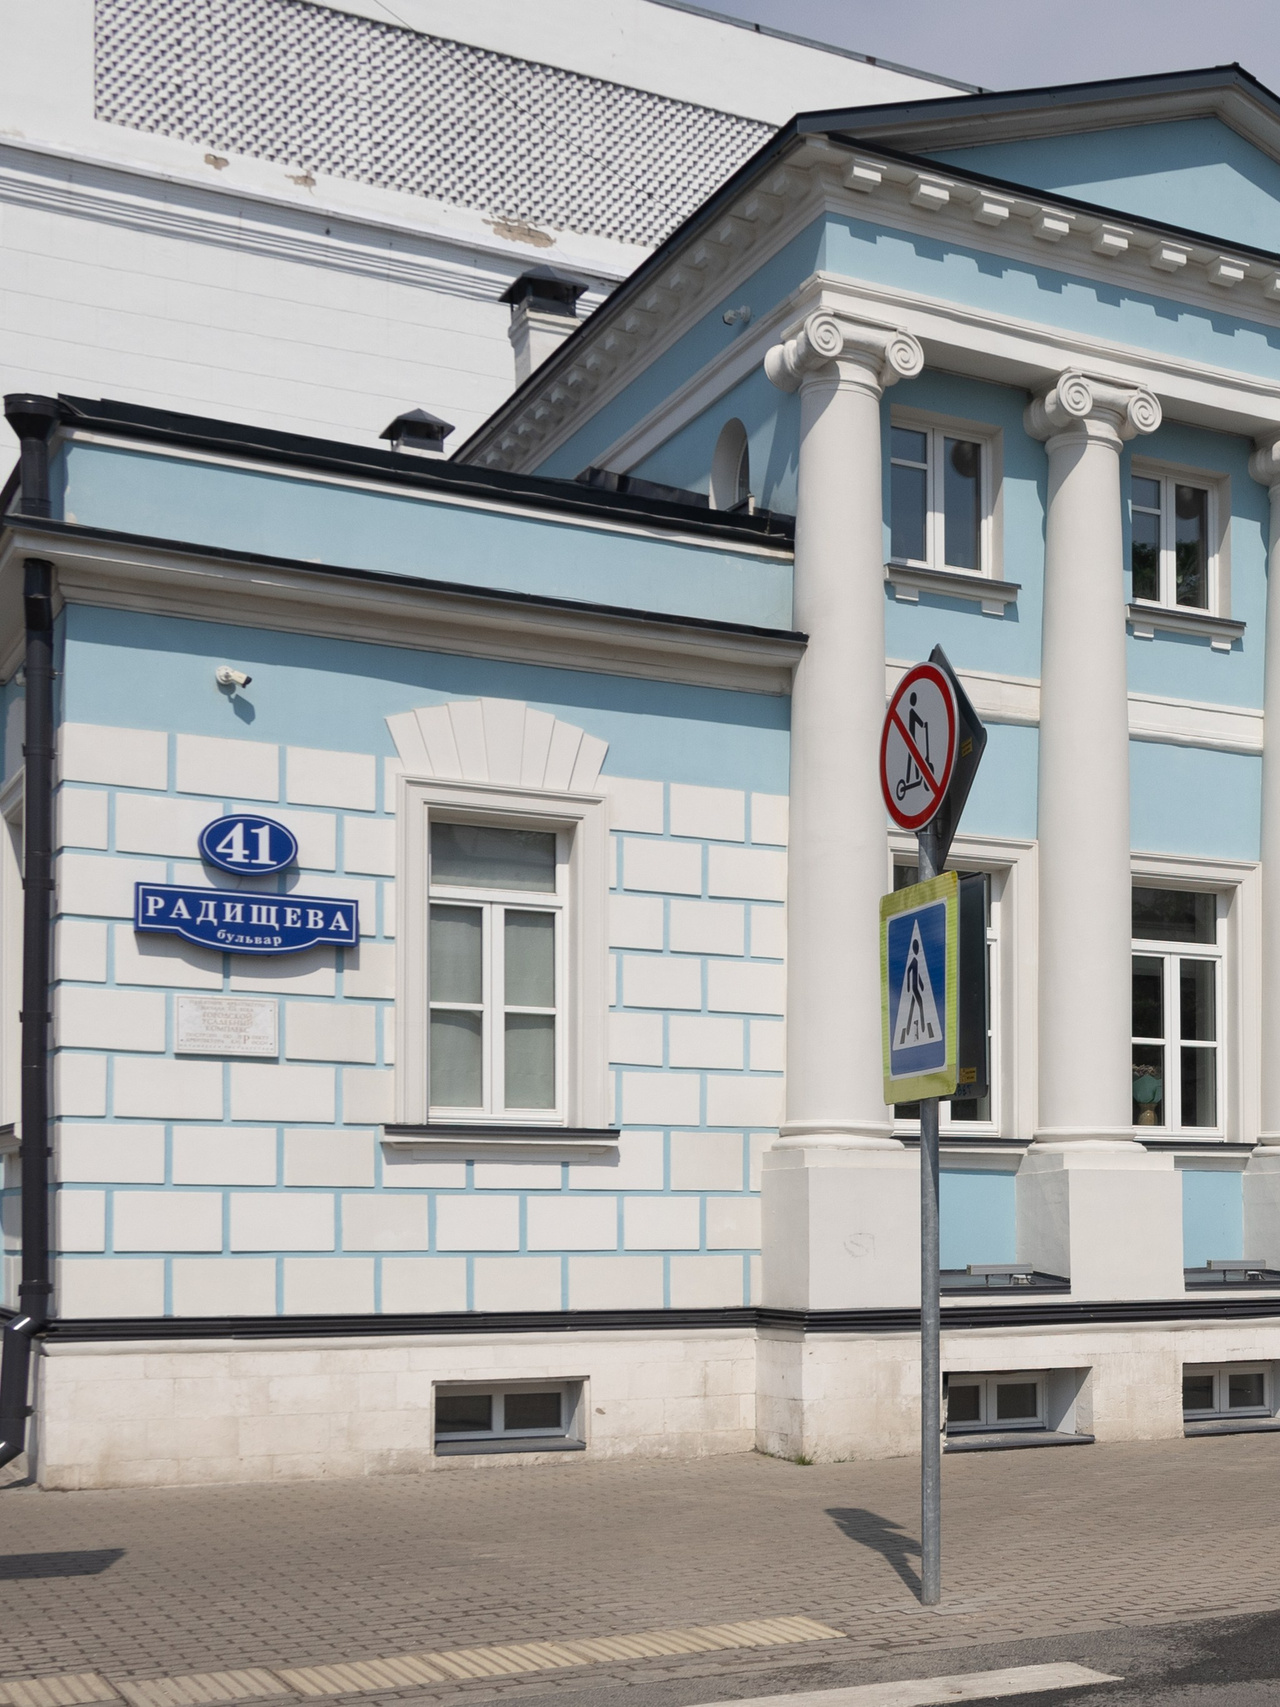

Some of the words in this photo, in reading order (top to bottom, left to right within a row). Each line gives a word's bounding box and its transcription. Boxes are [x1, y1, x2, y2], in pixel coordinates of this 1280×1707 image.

[215, 822, 277, 866] 41
[145, 895, 350, 932] РАДИЩЕВА
[216, 929, 283, 947] бульвар
